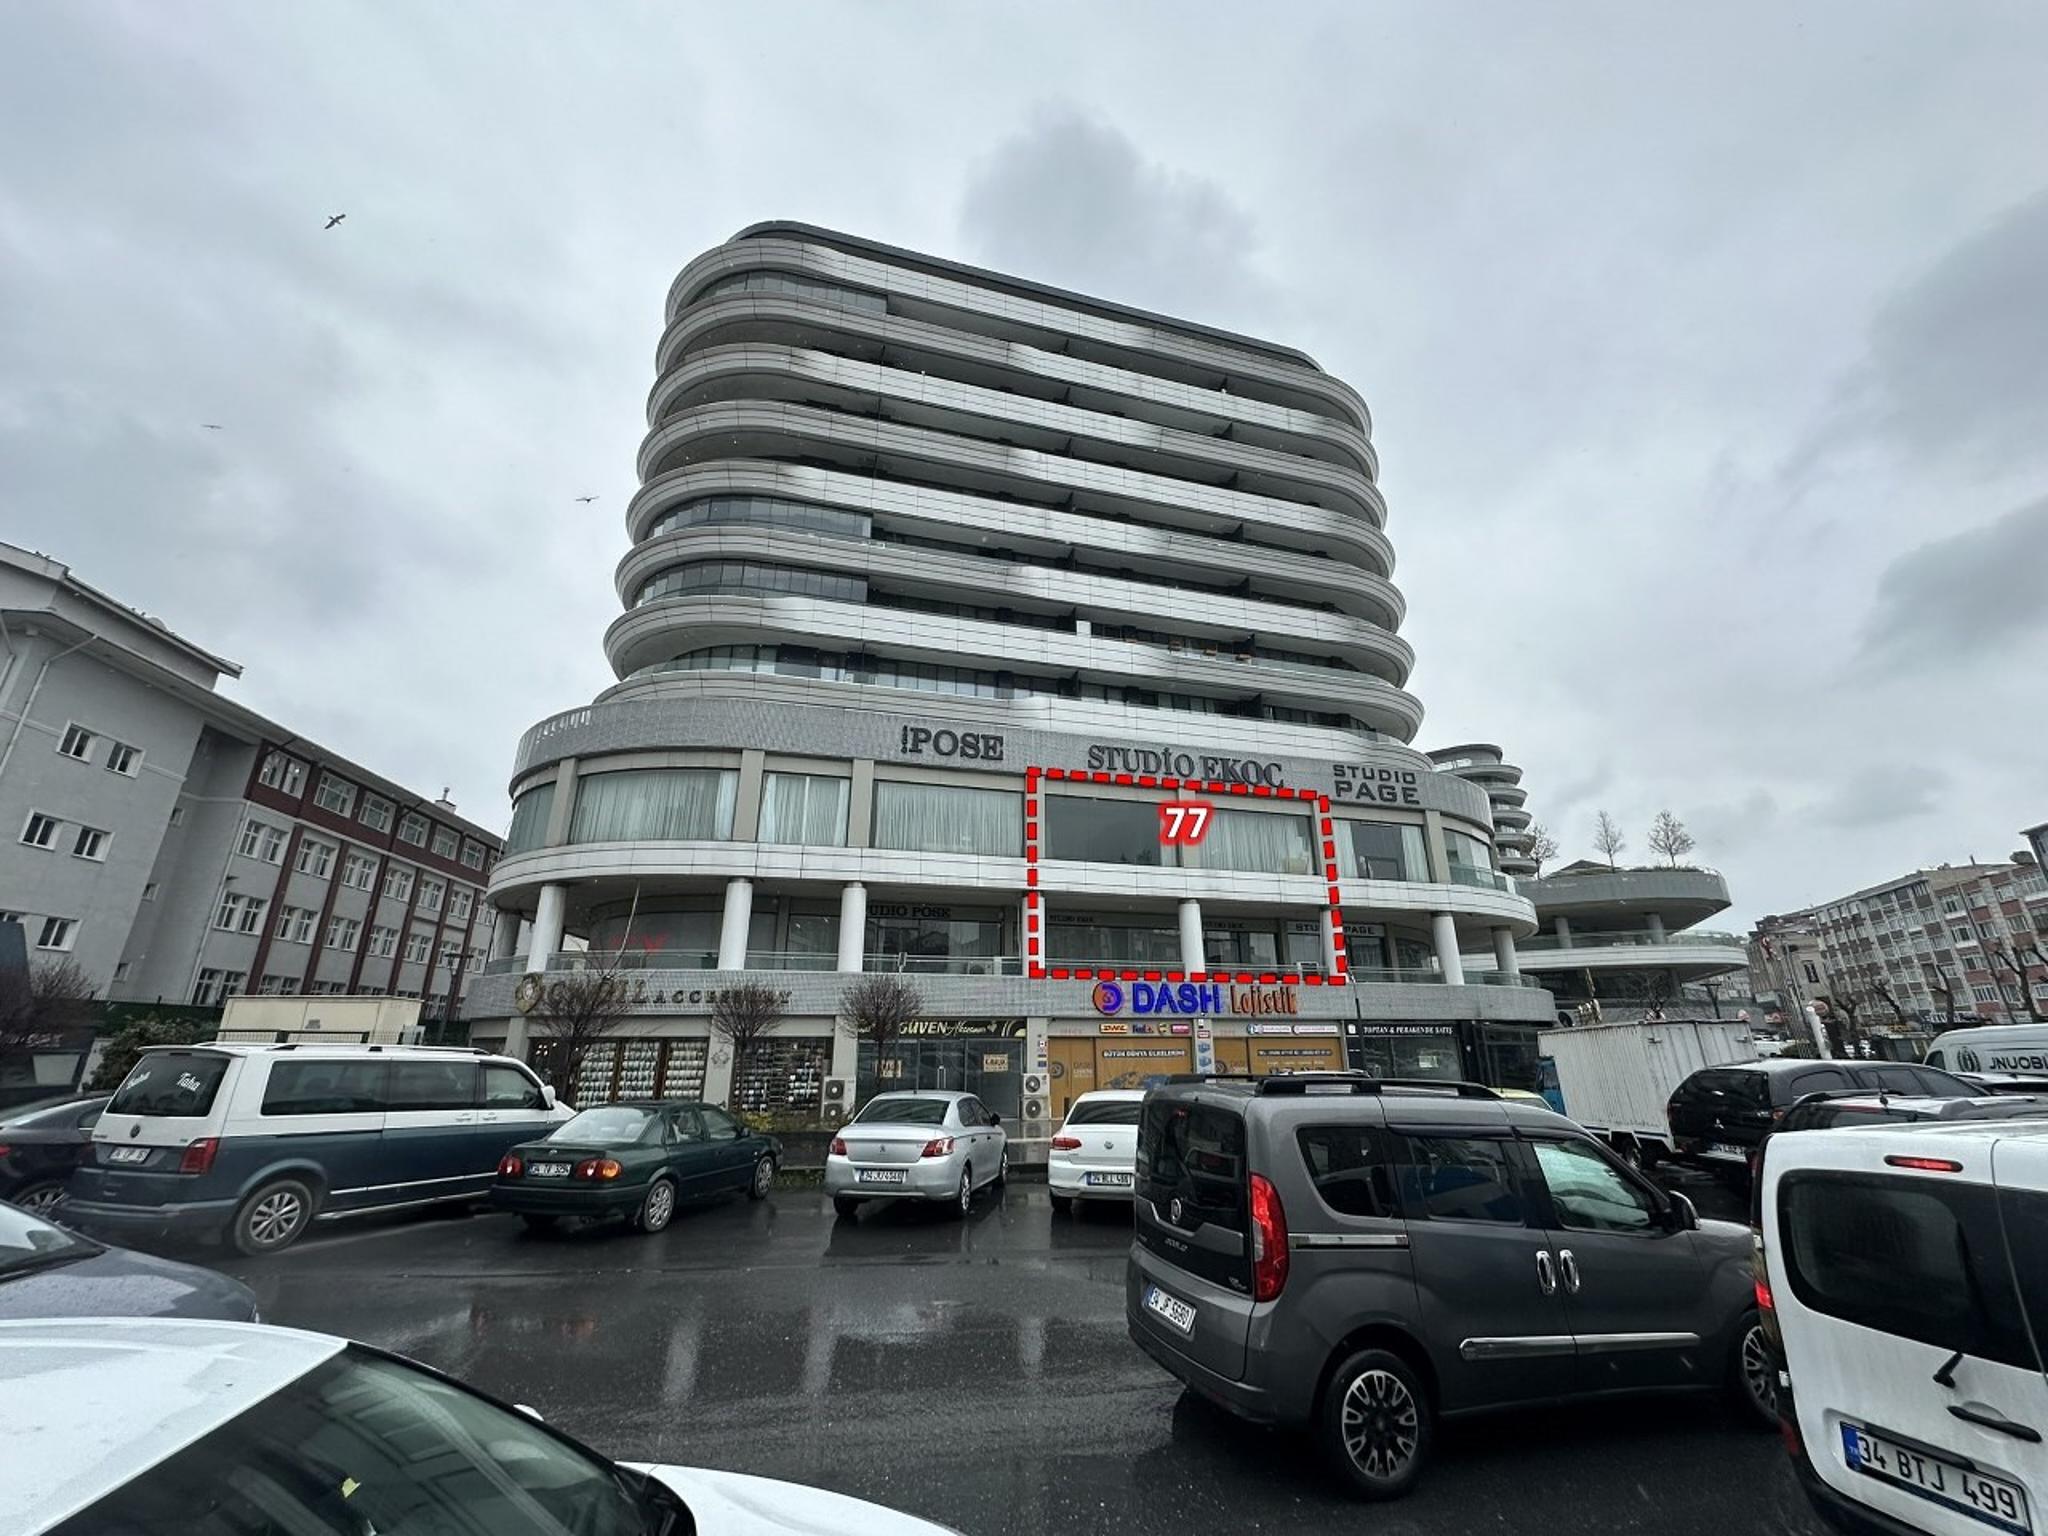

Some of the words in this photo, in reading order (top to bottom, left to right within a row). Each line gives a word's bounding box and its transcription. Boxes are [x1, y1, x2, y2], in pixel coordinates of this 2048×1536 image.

[909, 727, 1003, 760] POSE
[1333, 764, 1416, 784] STUDIO
[1335, 780, 1420, 805] PAGE
[1132, 983, 1221, 1014] DASH
[1230, 984, 1298, 1016] Lojistik
[1858, 1437, 1886, 1469] 34
[1896, 1450, 1945, 1491] BTJ
[1962, 1473, 2017, 1519] 499
